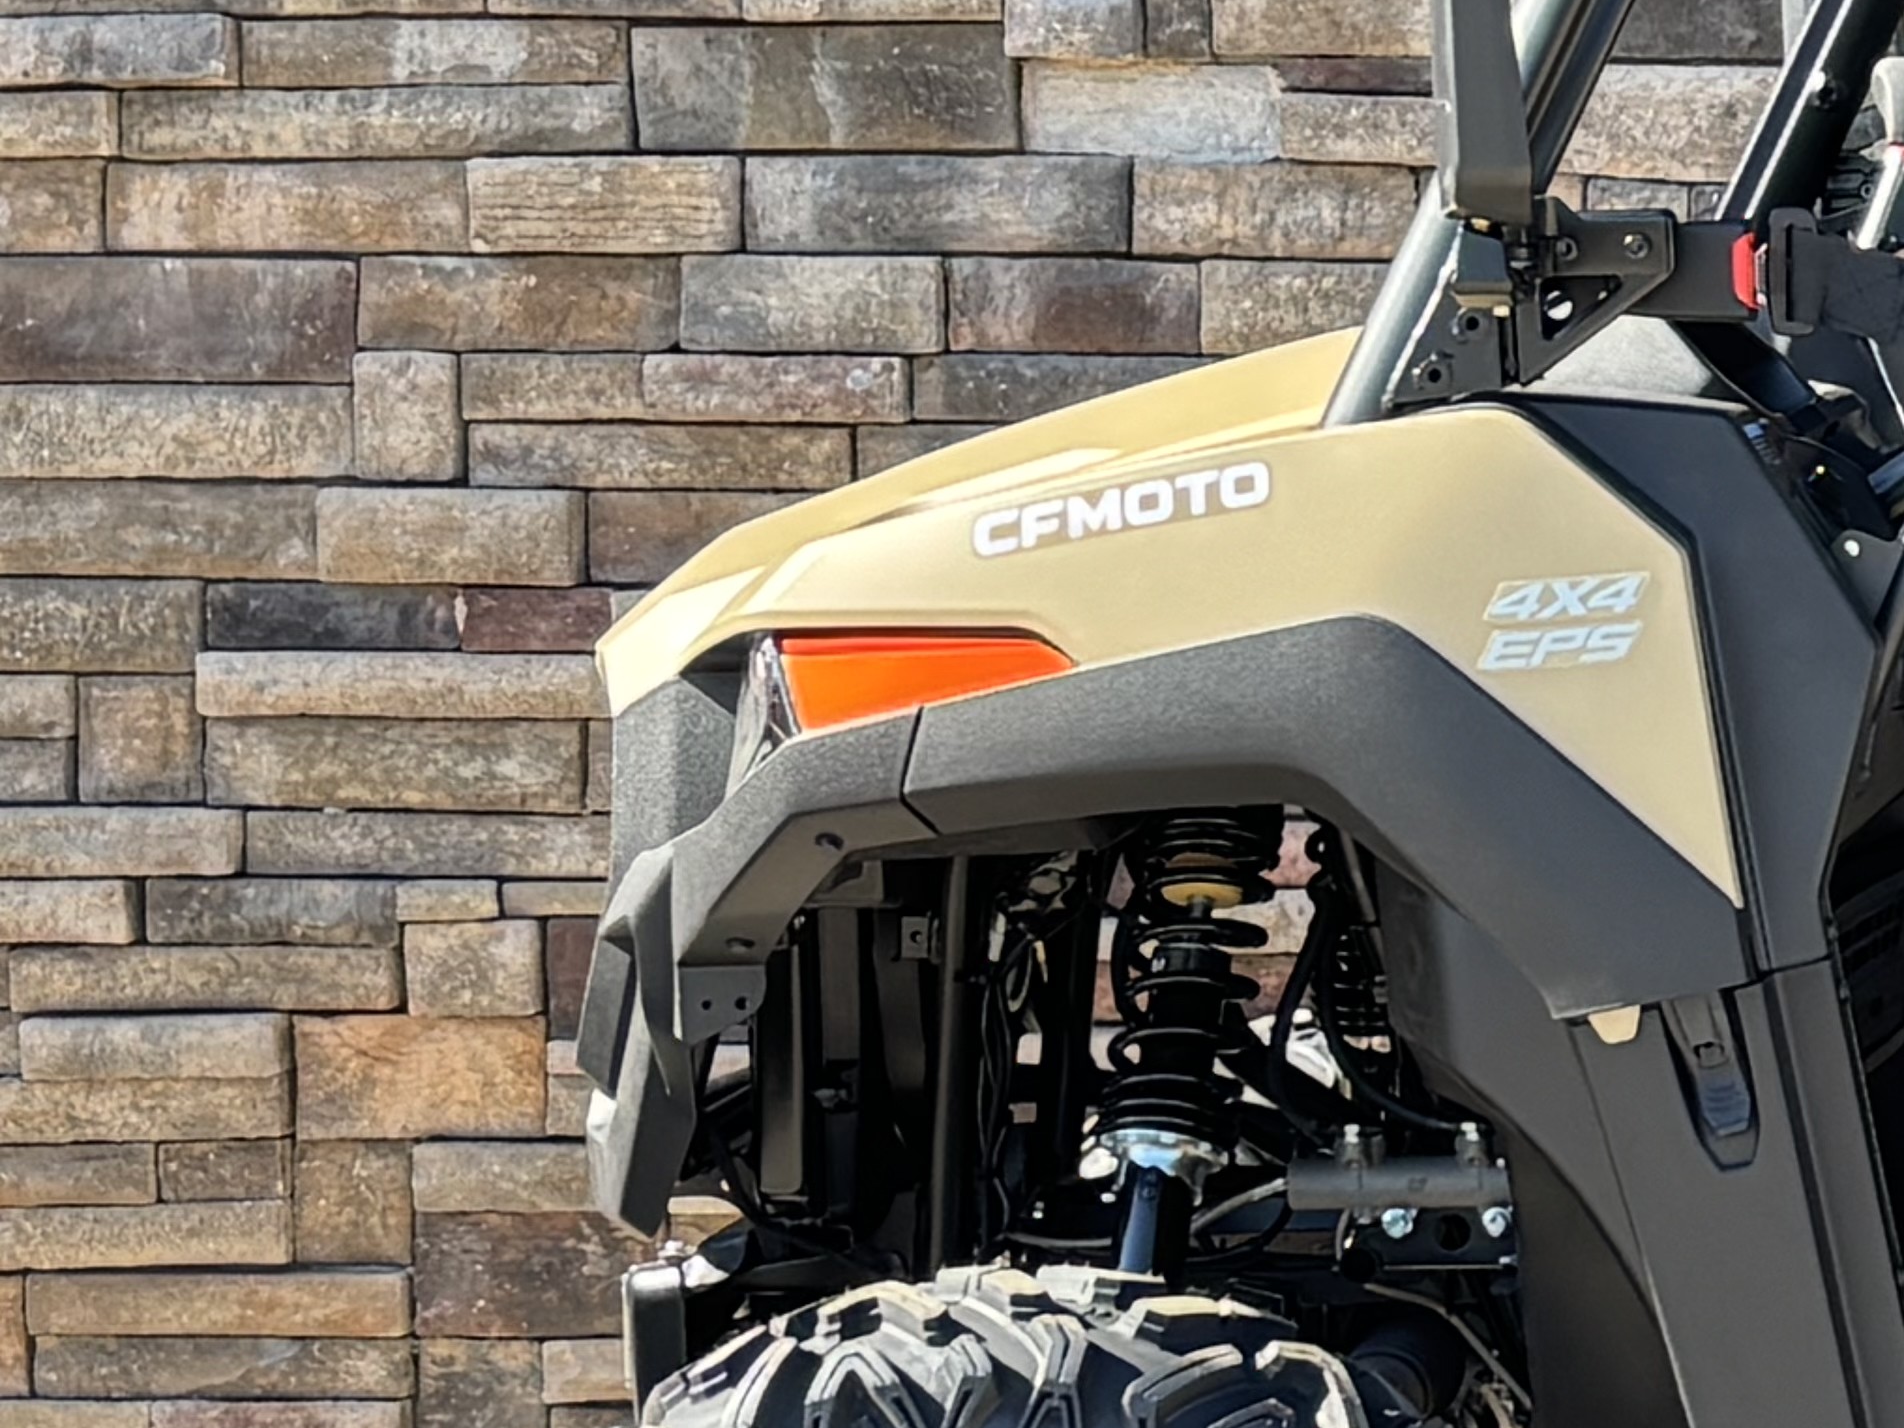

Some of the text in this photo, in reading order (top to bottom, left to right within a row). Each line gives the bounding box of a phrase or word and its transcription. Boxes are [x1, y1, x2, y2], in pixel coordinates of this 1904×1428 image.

[971, 460, 1272, 559] CFMOTO
[1486, 573, 1648, 622] 4X4
[1480, 621, 1642, 672] EPS
